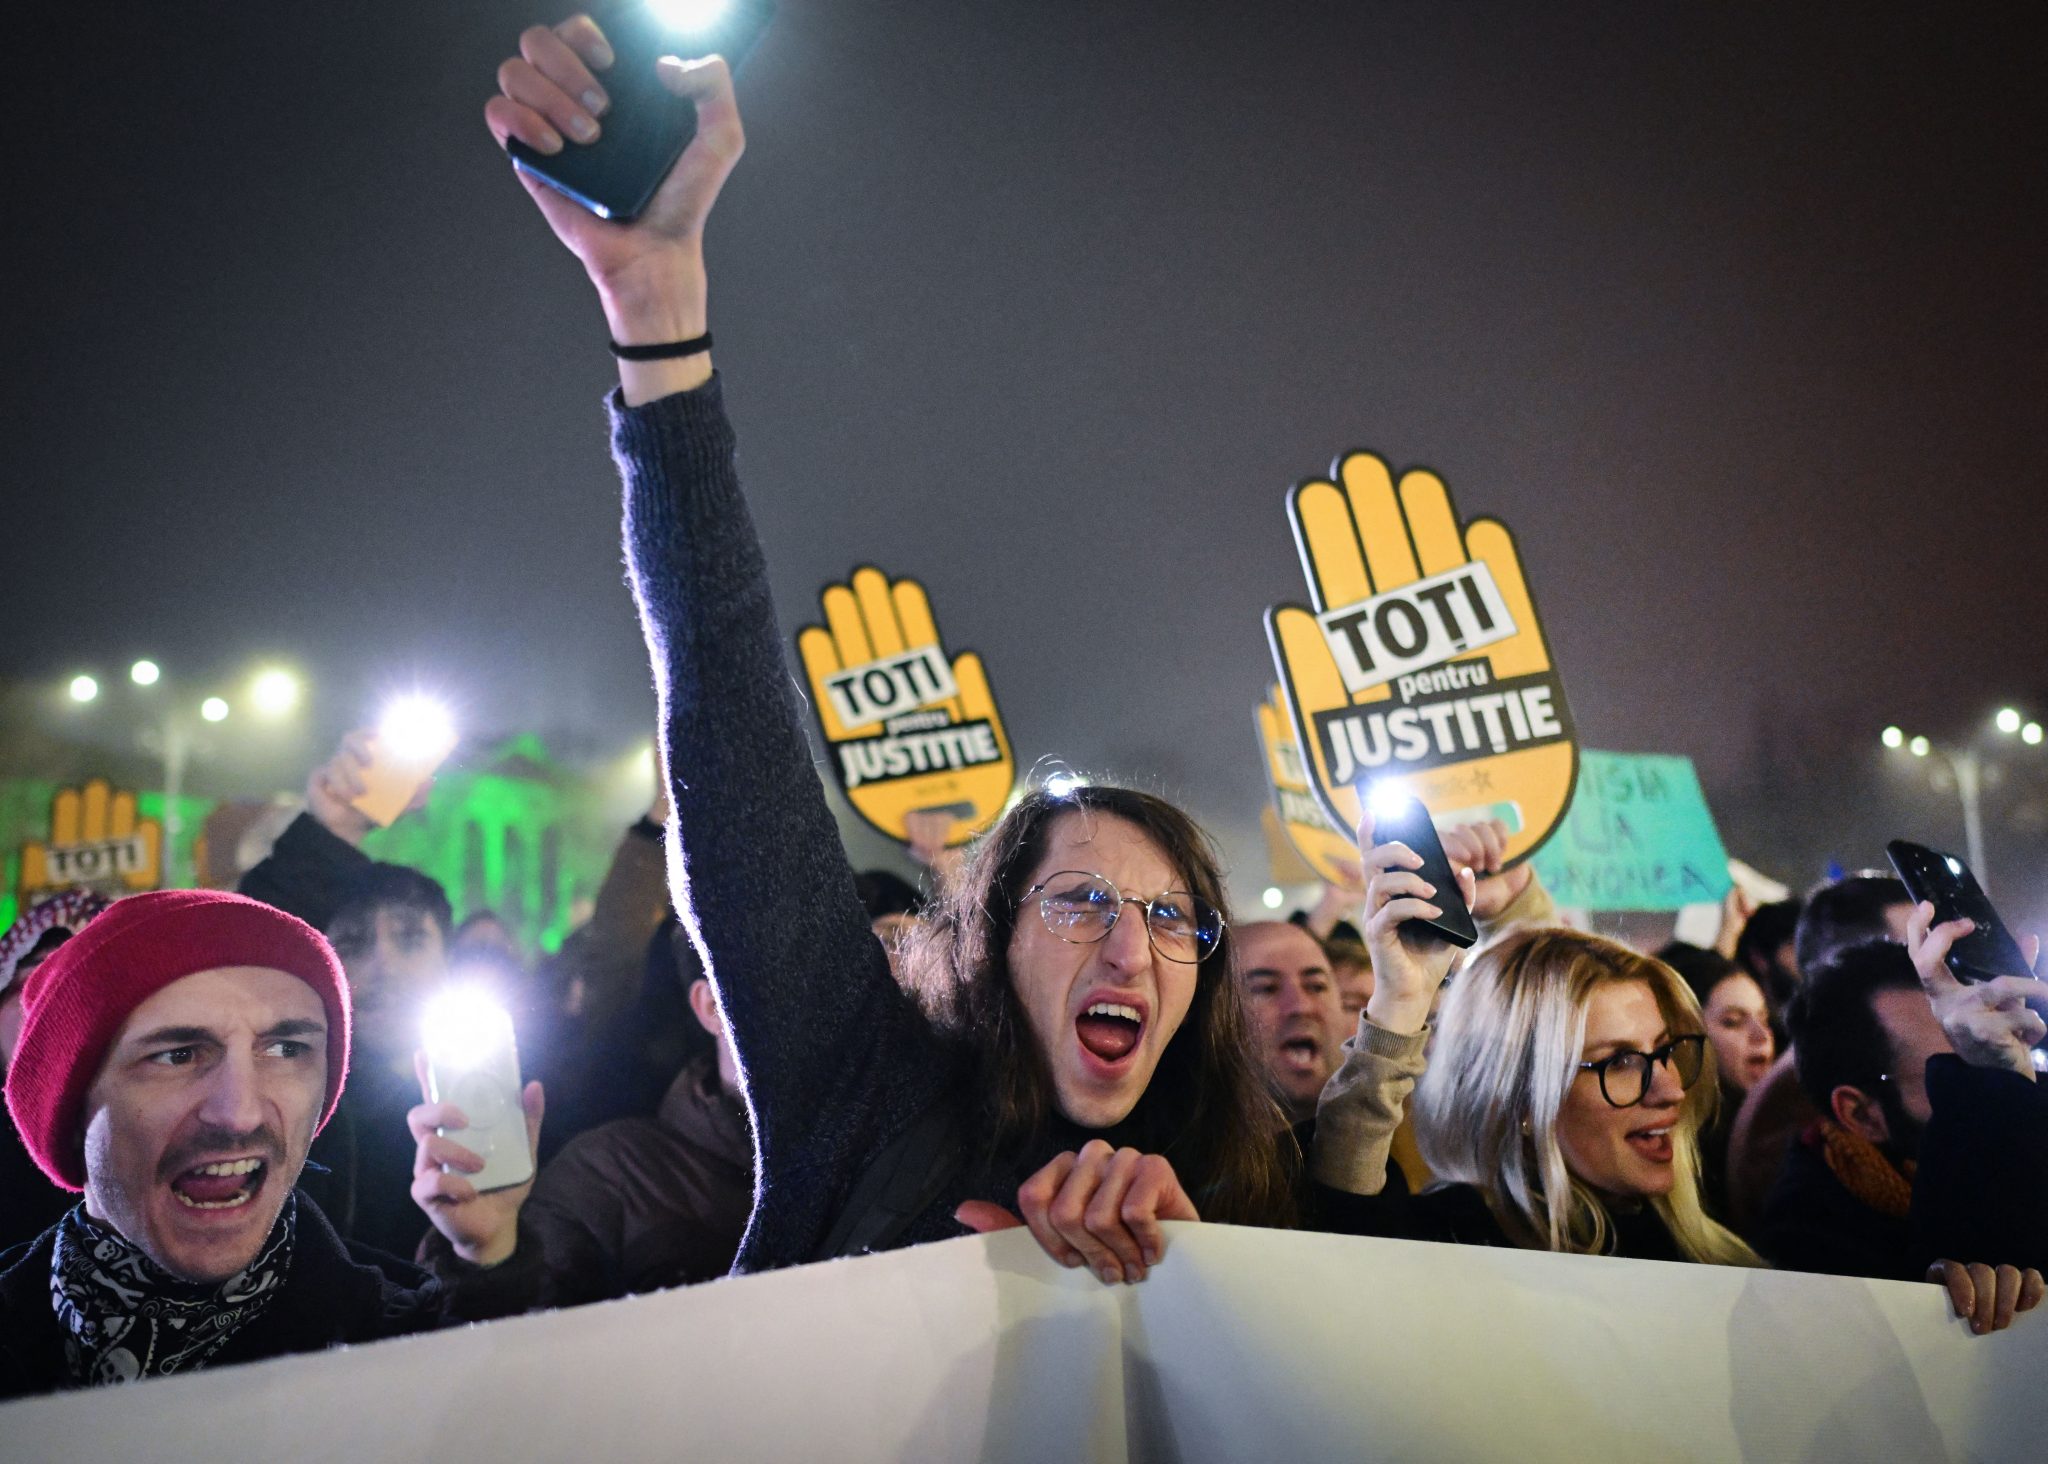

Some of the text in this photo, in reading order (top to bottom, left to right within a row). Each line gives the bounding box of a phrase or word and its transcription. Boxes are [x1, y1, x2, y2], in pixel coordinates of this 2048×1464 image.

[1327, 574, 1495, 672] TOȚI
[1399, 661, 1490, 703] pentru
[888, 711, 949, 733] pentru
[1326, 686, 1562, 781] JUSTIȚIE
